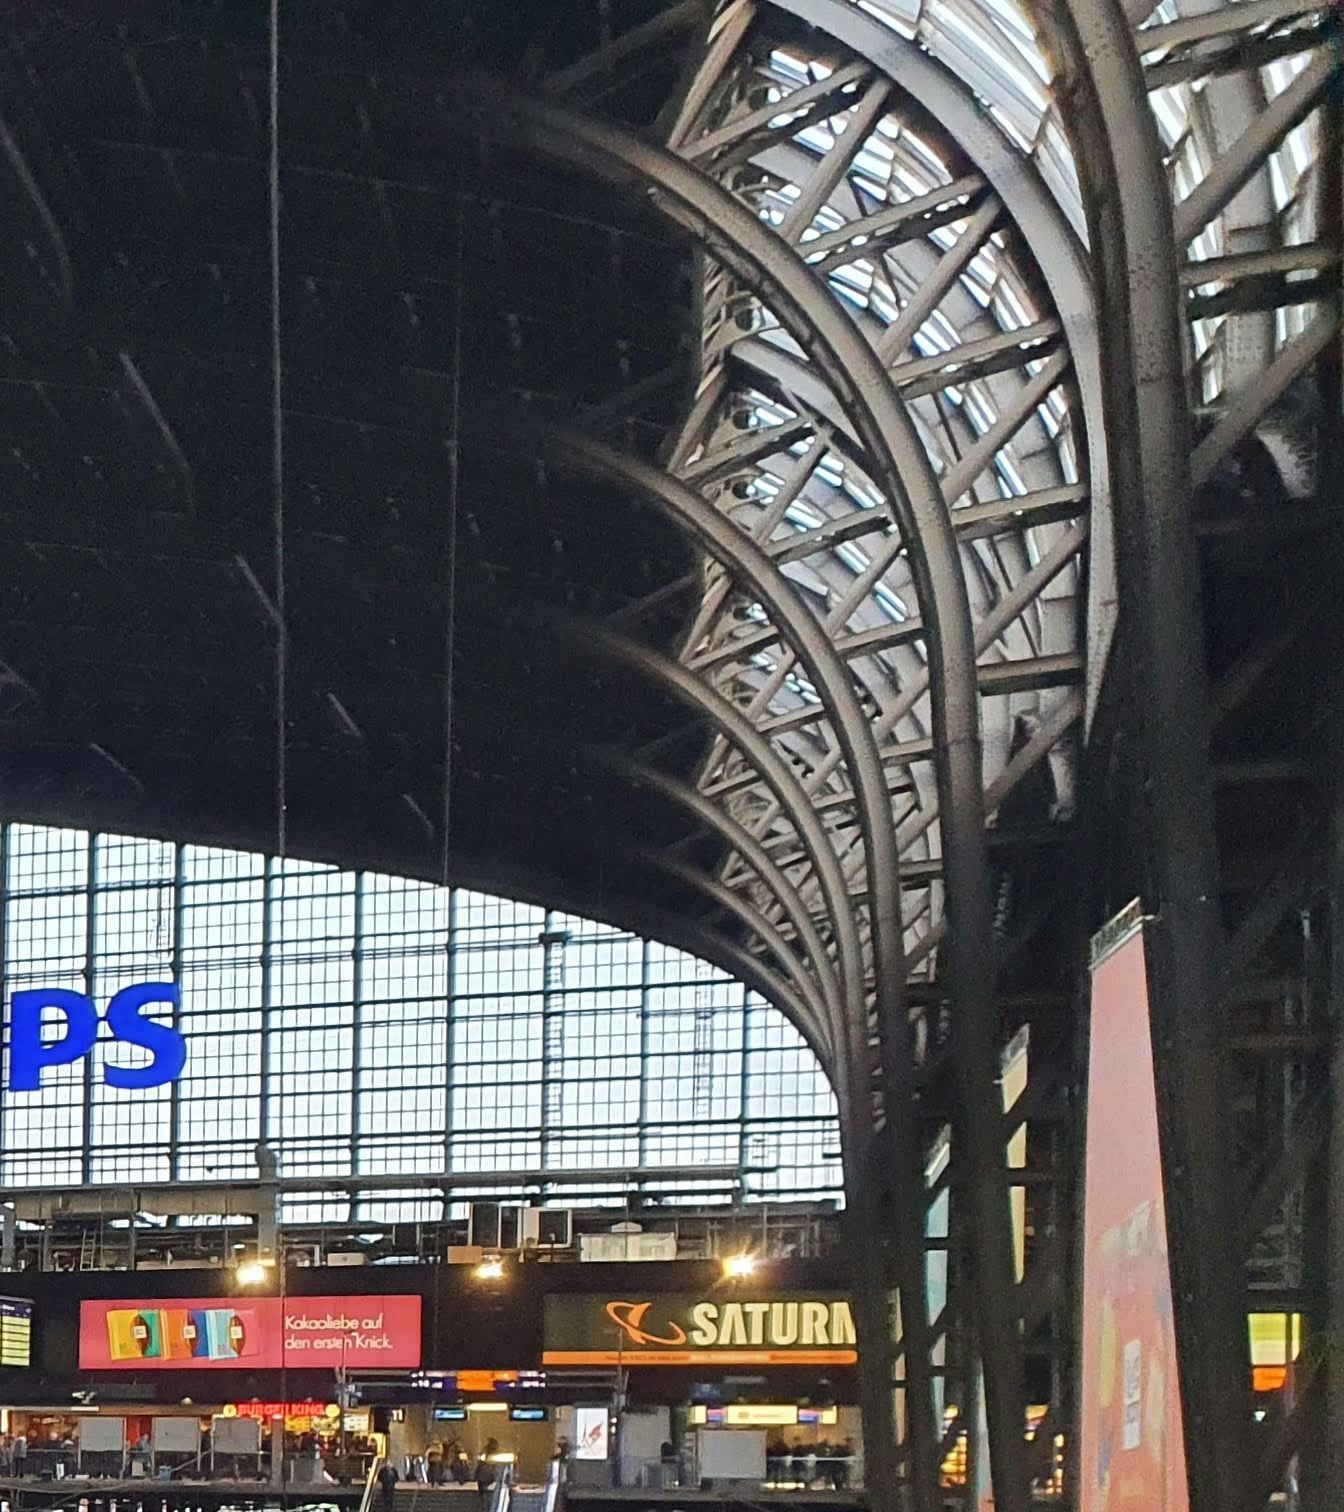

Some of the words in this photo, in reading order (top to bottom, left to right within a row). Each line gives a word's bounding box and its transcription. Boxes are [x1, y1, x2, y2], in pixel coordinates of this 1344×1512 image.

[284, 1313, 359, 1330] Kakaoliebe
[361, 1312, 383, 1330] auf
[284, 1333, 311, 1349] den
[313, 1335, 353, 1350] ersten
[355, 1332, 393, 1350] Knick.
[291, 1403, 325, 1417] KING
